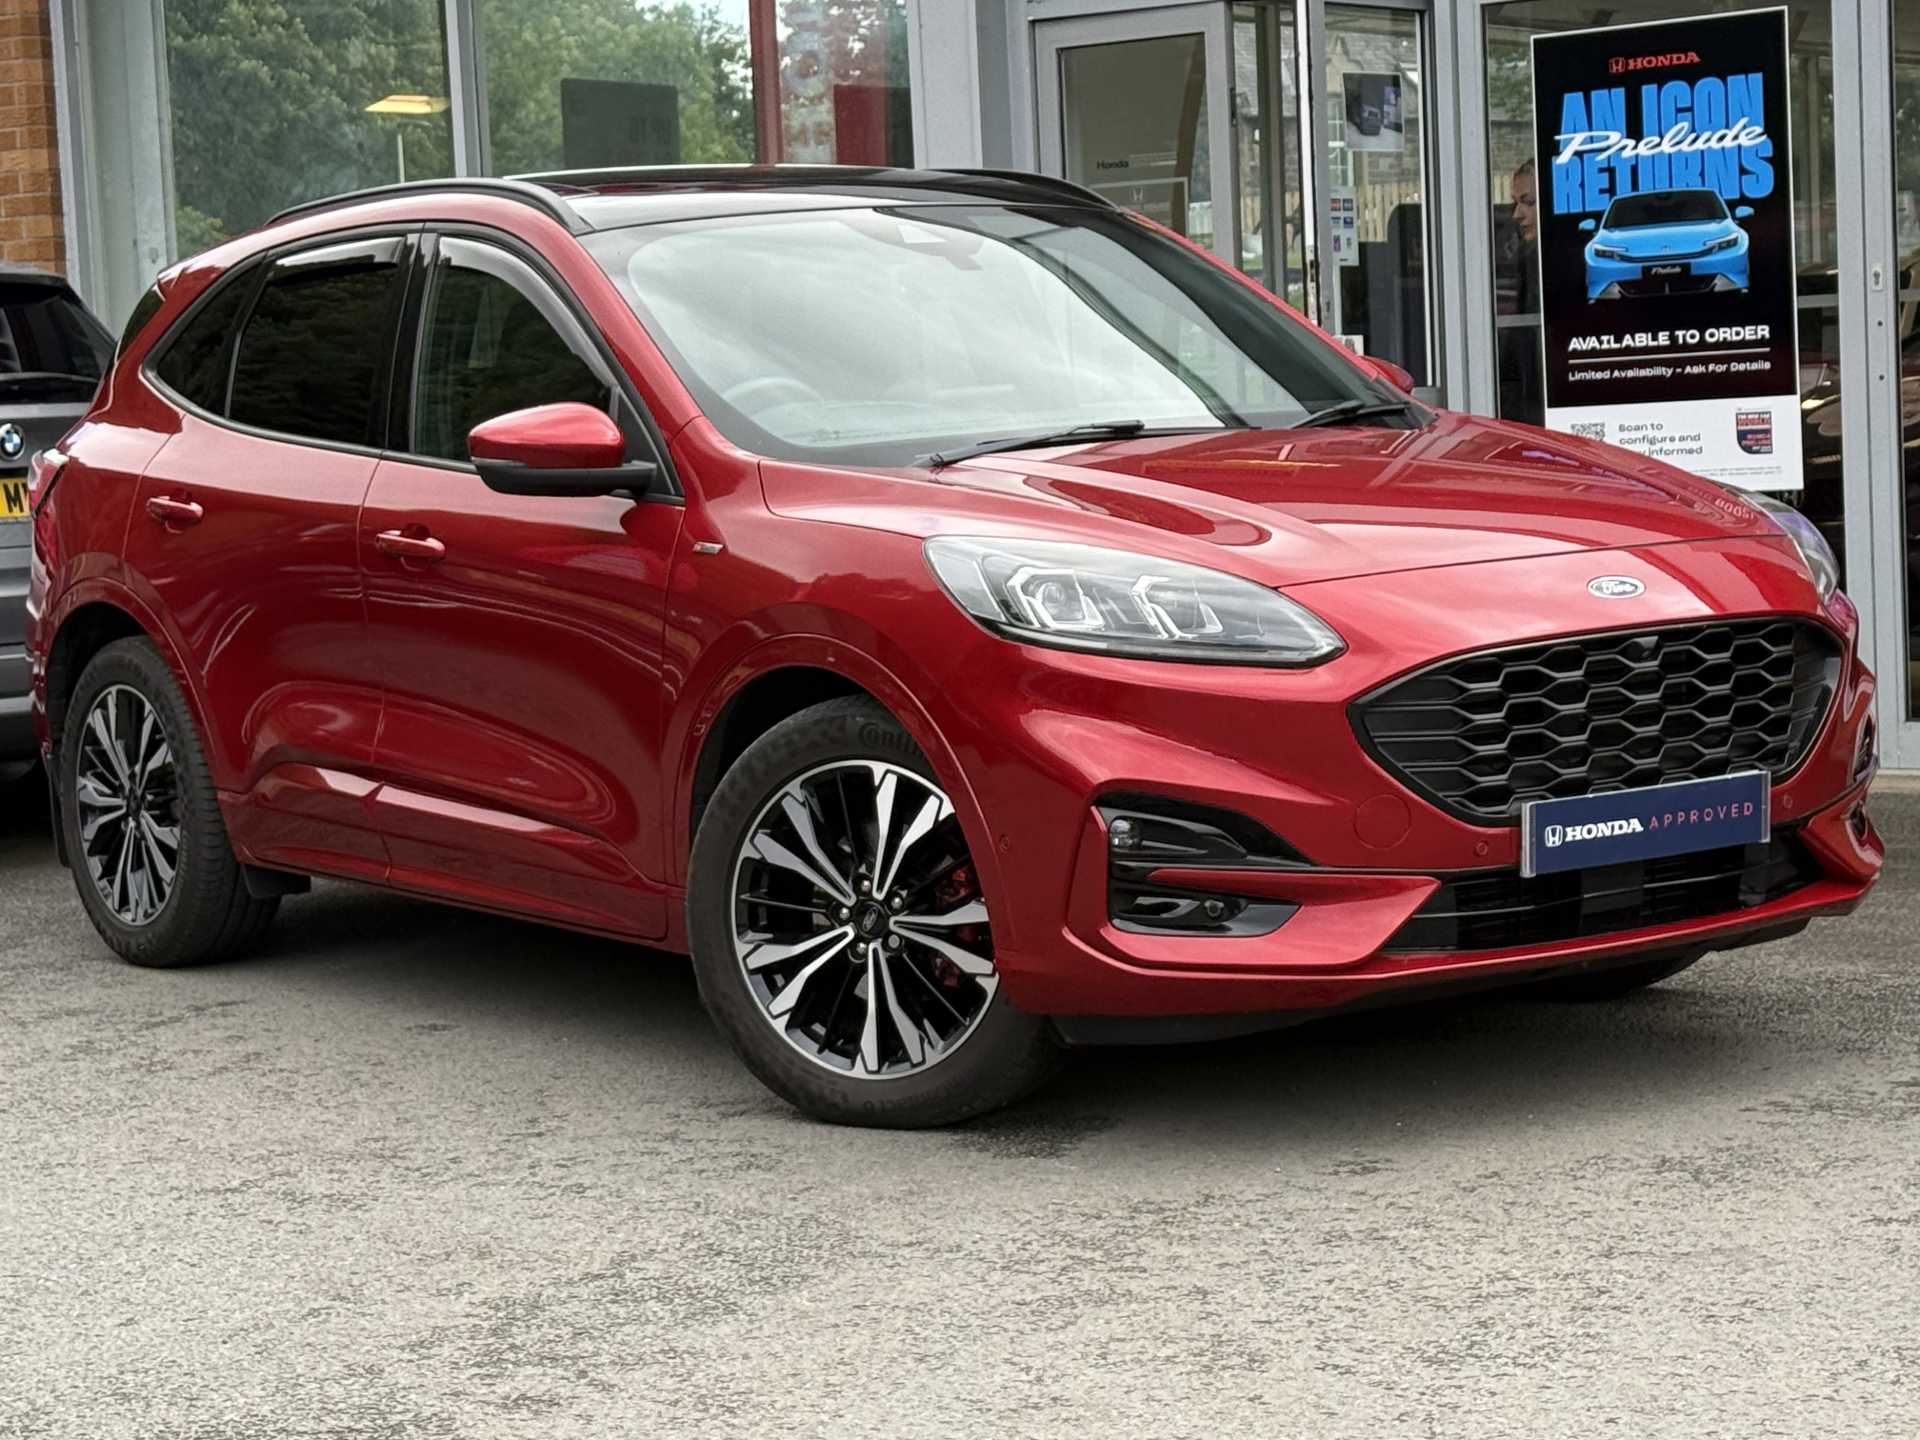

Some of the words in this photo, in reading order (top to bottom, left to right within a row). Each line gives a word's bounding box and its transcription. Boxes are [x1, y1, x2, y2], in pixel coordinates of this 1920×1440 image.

[1627, 52, 1701, 70] HONDA
[1559, 87, 1627, 150] AN
[1641, 72, 1764, 146] ICON
[1554, 117, 1767, 164] Prelude
[1552, 138, 1774, 214] RETURNS
[1568, 332, 1670, 351] AVAILABLE
[1675, 329, 1700, 344] TO
[1705, 325, 1770, 343] ORDER
[1568, 371, 1611, 381] Limited
[1612, 366, 1674, 378] Availability
[1684, 364, 1706, 375] Ask
[1708, 362, 1728, 373] For
[1730, 360, 1771, 372] Details
[1650, 423, 1664, 431] to
[1619, 435, 1676, 446] configure
[1678, 433, 1701, 442] and
[1648, 446, 1703, 456] informed
[1565, 818, 1643, 842] HONDA
[1649, 802, 1754, 830] APPROVED
